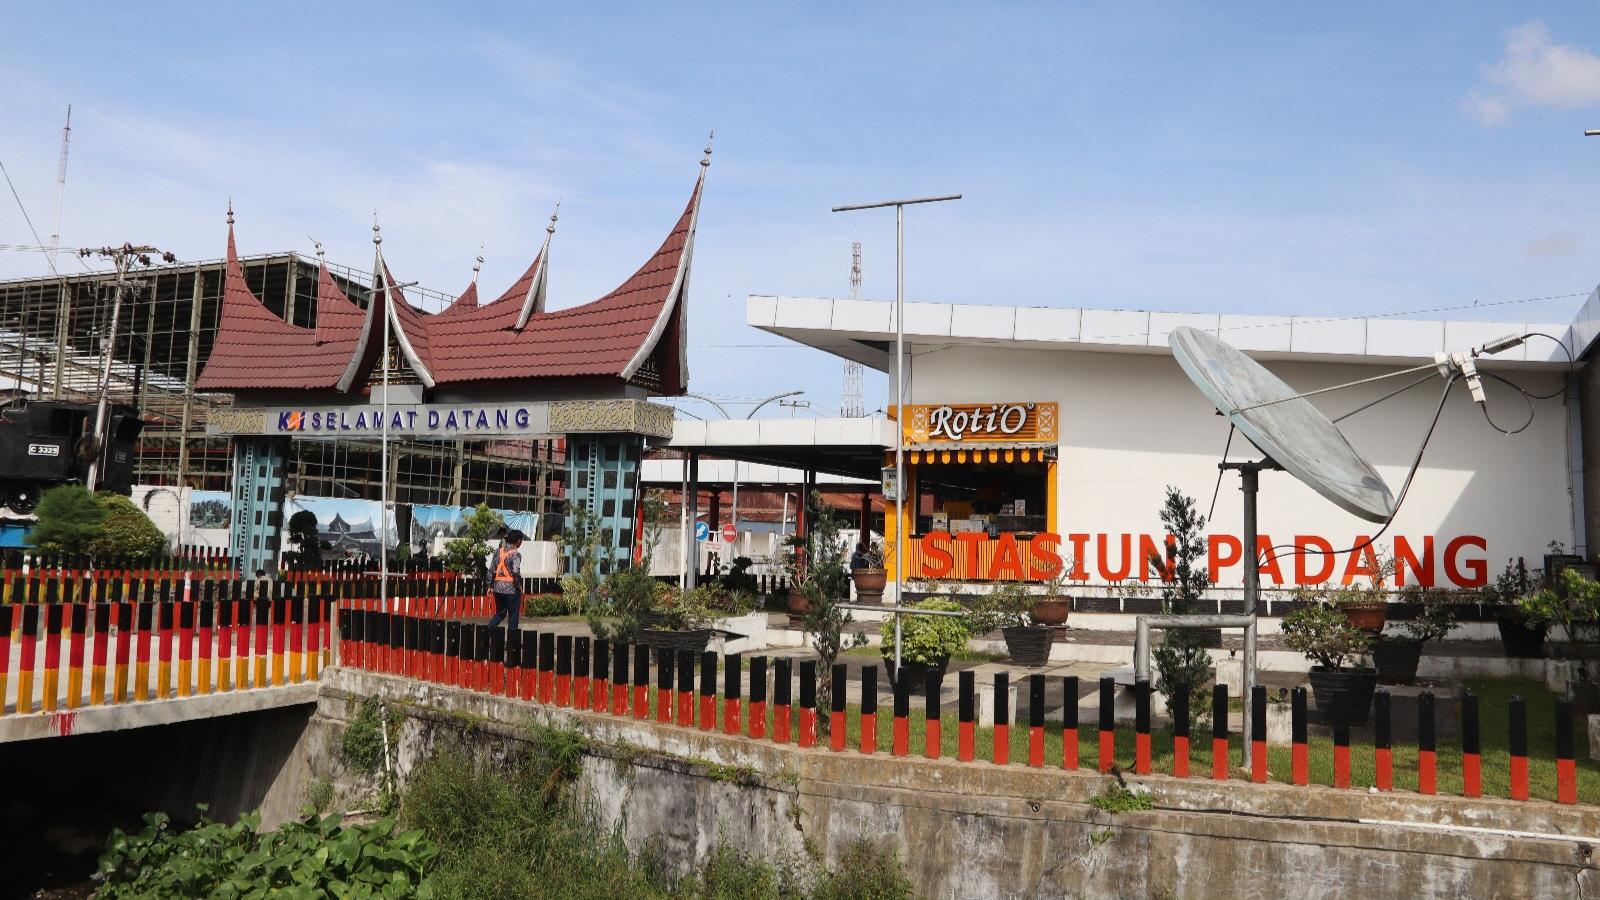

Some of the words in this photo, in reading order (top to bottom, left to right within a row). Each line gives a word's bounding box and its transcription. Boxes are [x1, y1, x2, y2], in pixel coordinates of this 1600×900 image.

[277, 411, 306, 431] KAI
[311, 410, 418, 430] SELAMAT
[427, 408, 530, 429] DATANG
[38, 446, 58, 454] 3325
[921, 530, 1176, 584] STASIUN
[1207, 534, 1488, 589] PADANG
